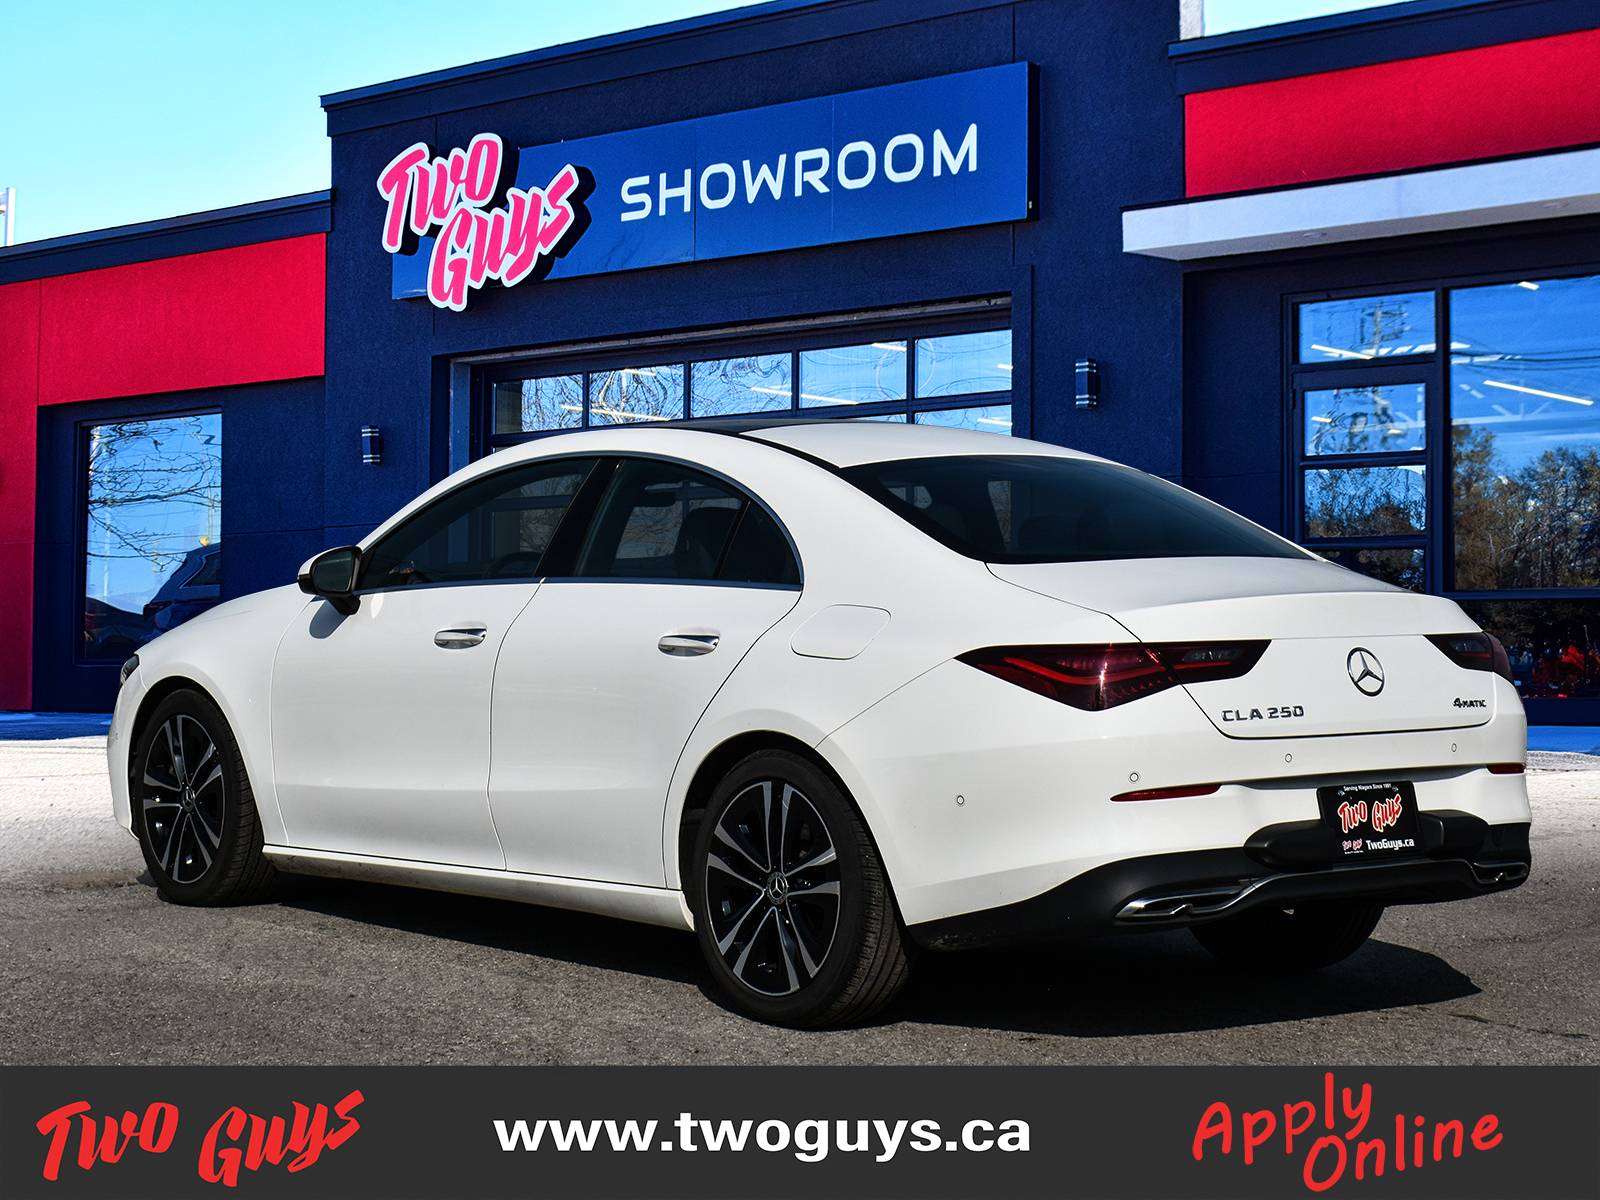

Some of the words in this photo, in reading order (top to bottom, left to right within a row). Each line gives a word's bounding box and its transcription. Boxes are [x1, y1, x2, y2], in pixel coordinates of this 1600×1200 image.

[379, 135, 502, 252] Two
[620, 123, 978, 222] SHOWROOM
[429, 165, 578, 309] Guys
[1222, 708, 1264, 722] CLA
[1267, 705, 1305, 719] 250
[1337, 801, 1368, 834] Two
[1371, 793, 1403, 833] Guys
[1365, 838, 1415, 851] TwoGuys.ca
